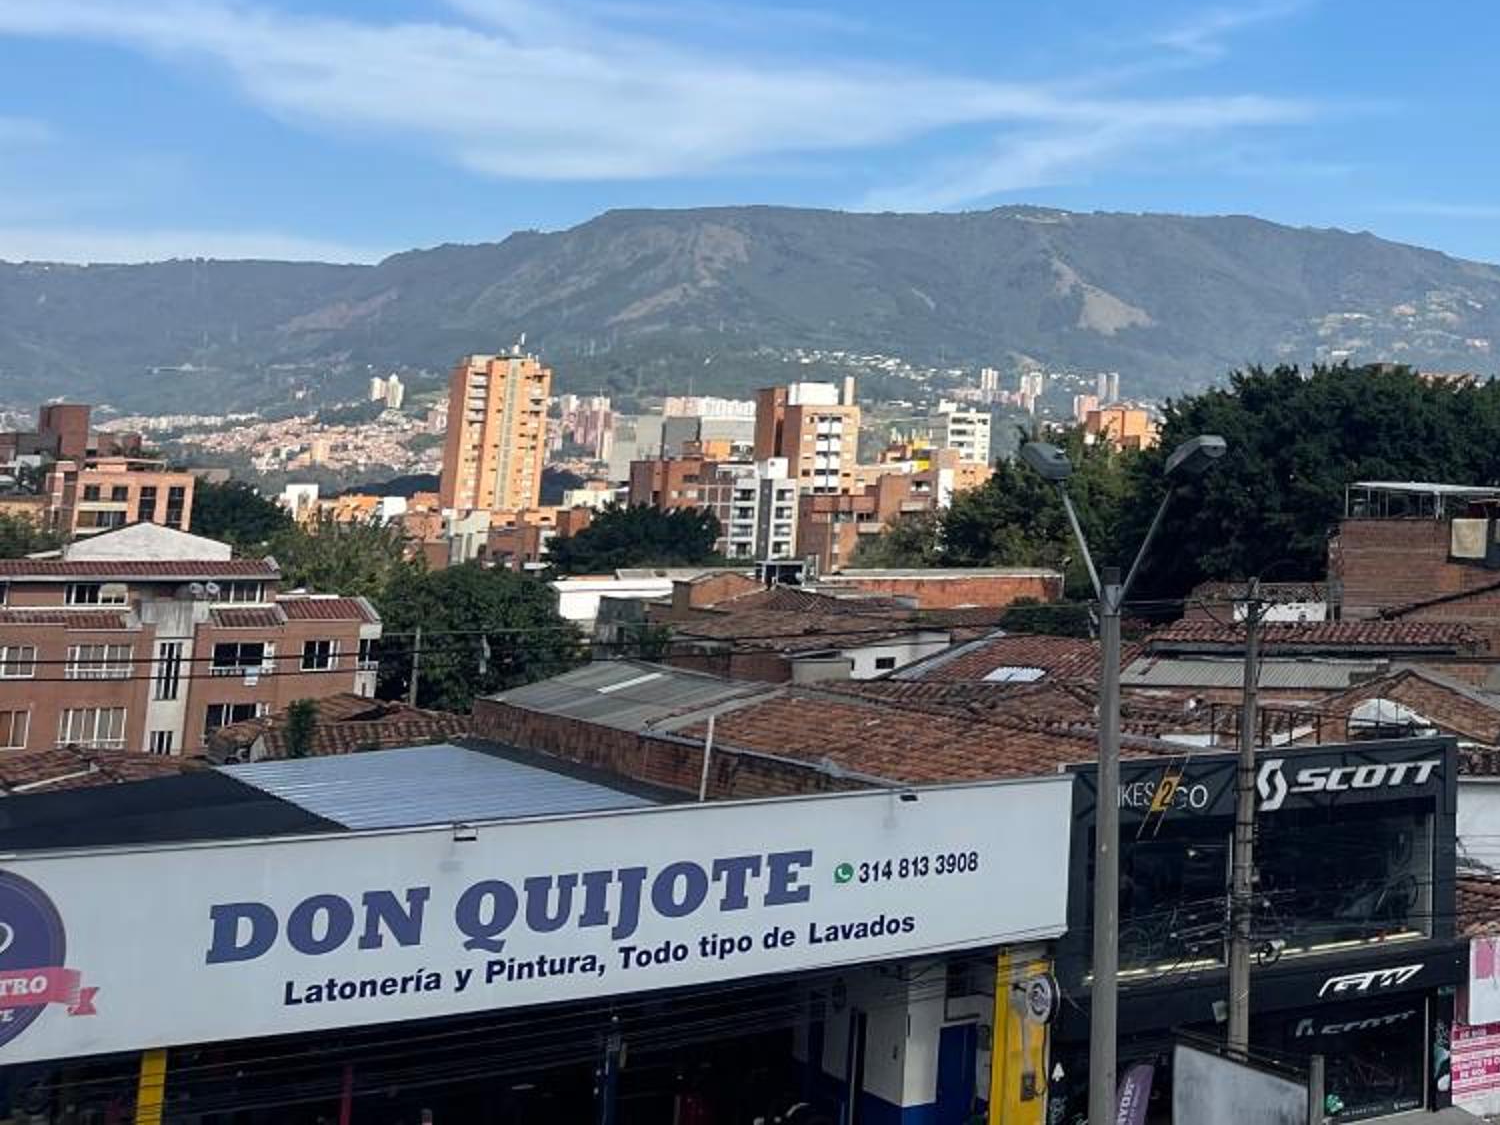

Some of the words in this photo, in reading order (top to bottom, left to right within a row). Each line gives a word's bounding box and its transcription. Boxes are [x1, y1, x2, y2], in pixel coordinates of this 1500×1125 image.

[1290, 760, 1441, 793] SCOTT
[858, 860, 893, 884] 314
[898, 855, 930, 879] 813
[935, 851, 979, 875] 3908
[205, 886, 431, 965] DON
[454, 850, 813, 954] QUIJOTE
[284, 968, 442, 1006] Latonería
[454, 968, 473, 993] y
[485, 953, 606, 985] Pintura,
[618, 940, 690, 970] Todo
[698, 933, 753, 960] tipo
[763, 926, 797, 950] de
[808, 914, 916, 945] Lavados
